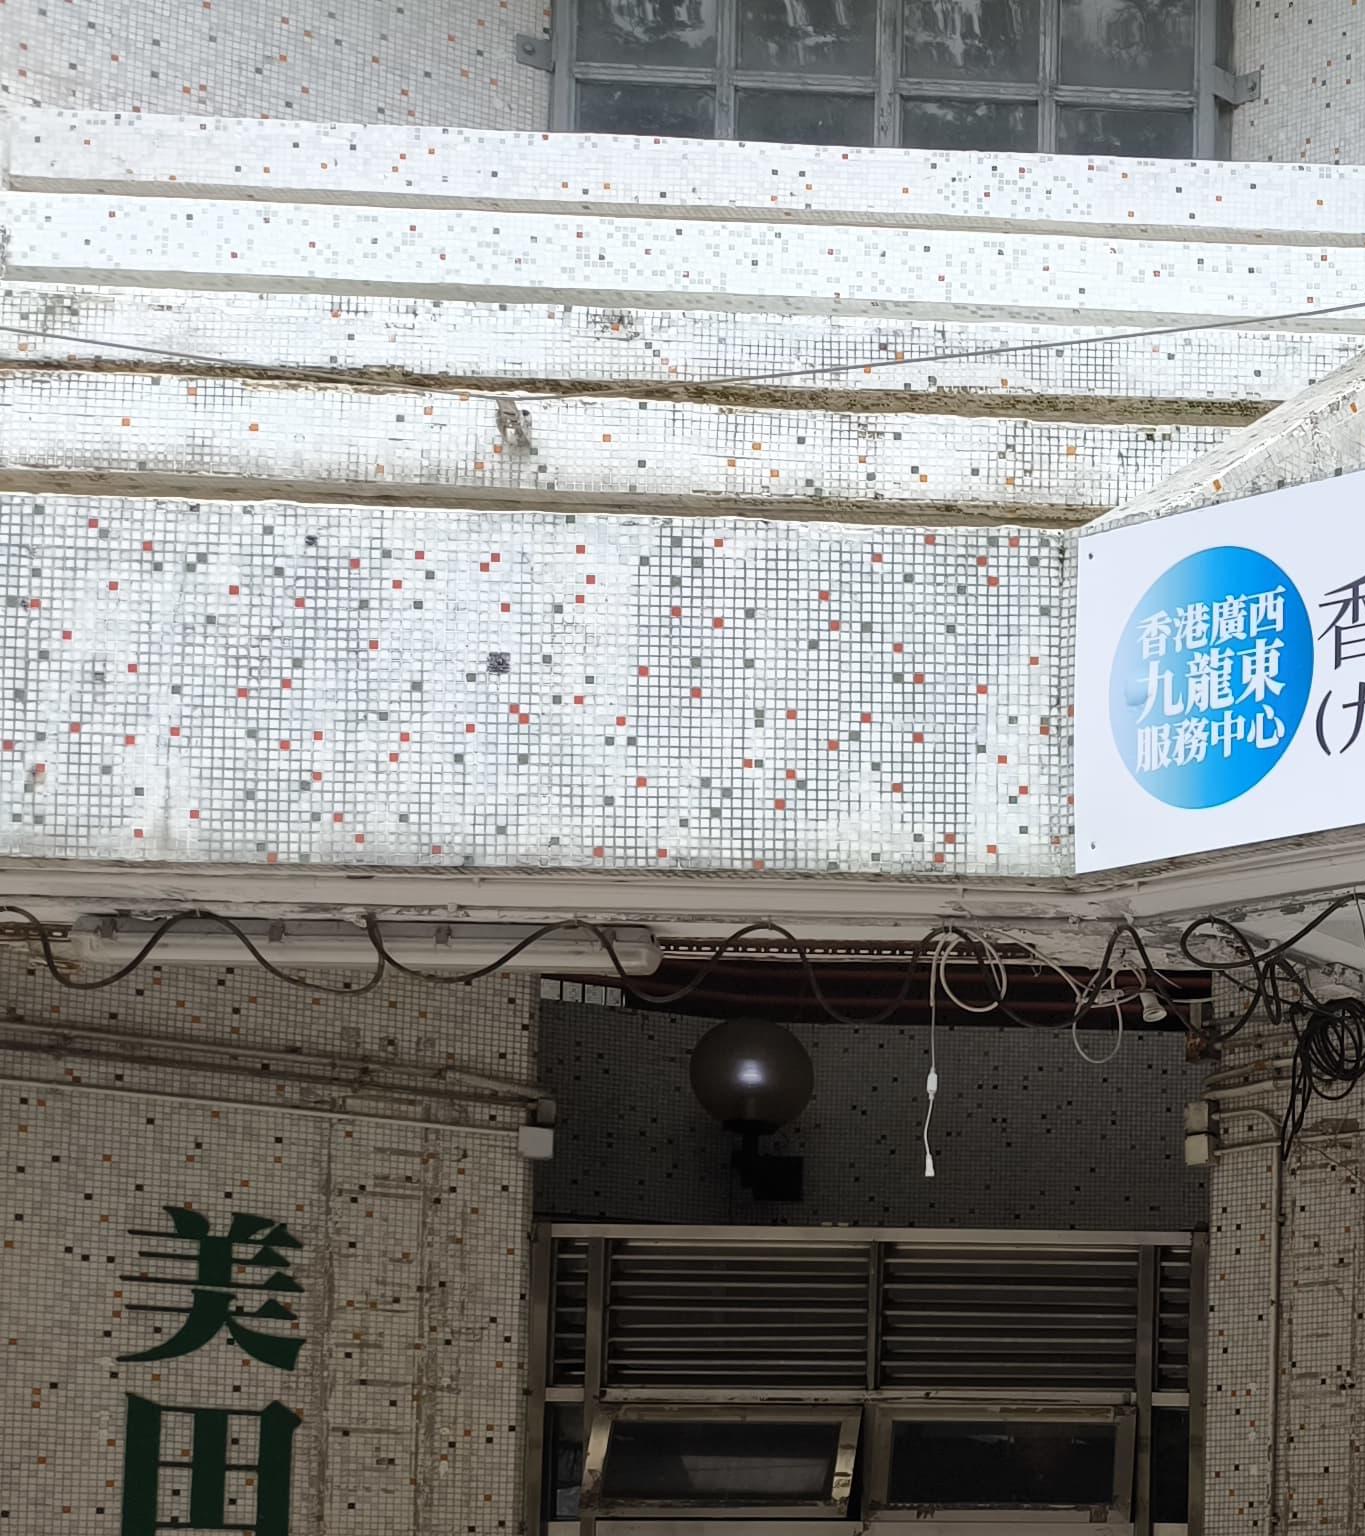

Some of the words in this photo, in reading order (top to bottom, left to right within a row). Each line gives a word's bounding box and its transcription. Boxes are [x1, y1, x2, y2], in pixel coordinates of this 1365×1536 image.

[1137, 585, 1286, 658] 香港廣西
[1138, 637, 1284, 723] 九龍東
[1136, 705, 1286, 774] 服務中心
